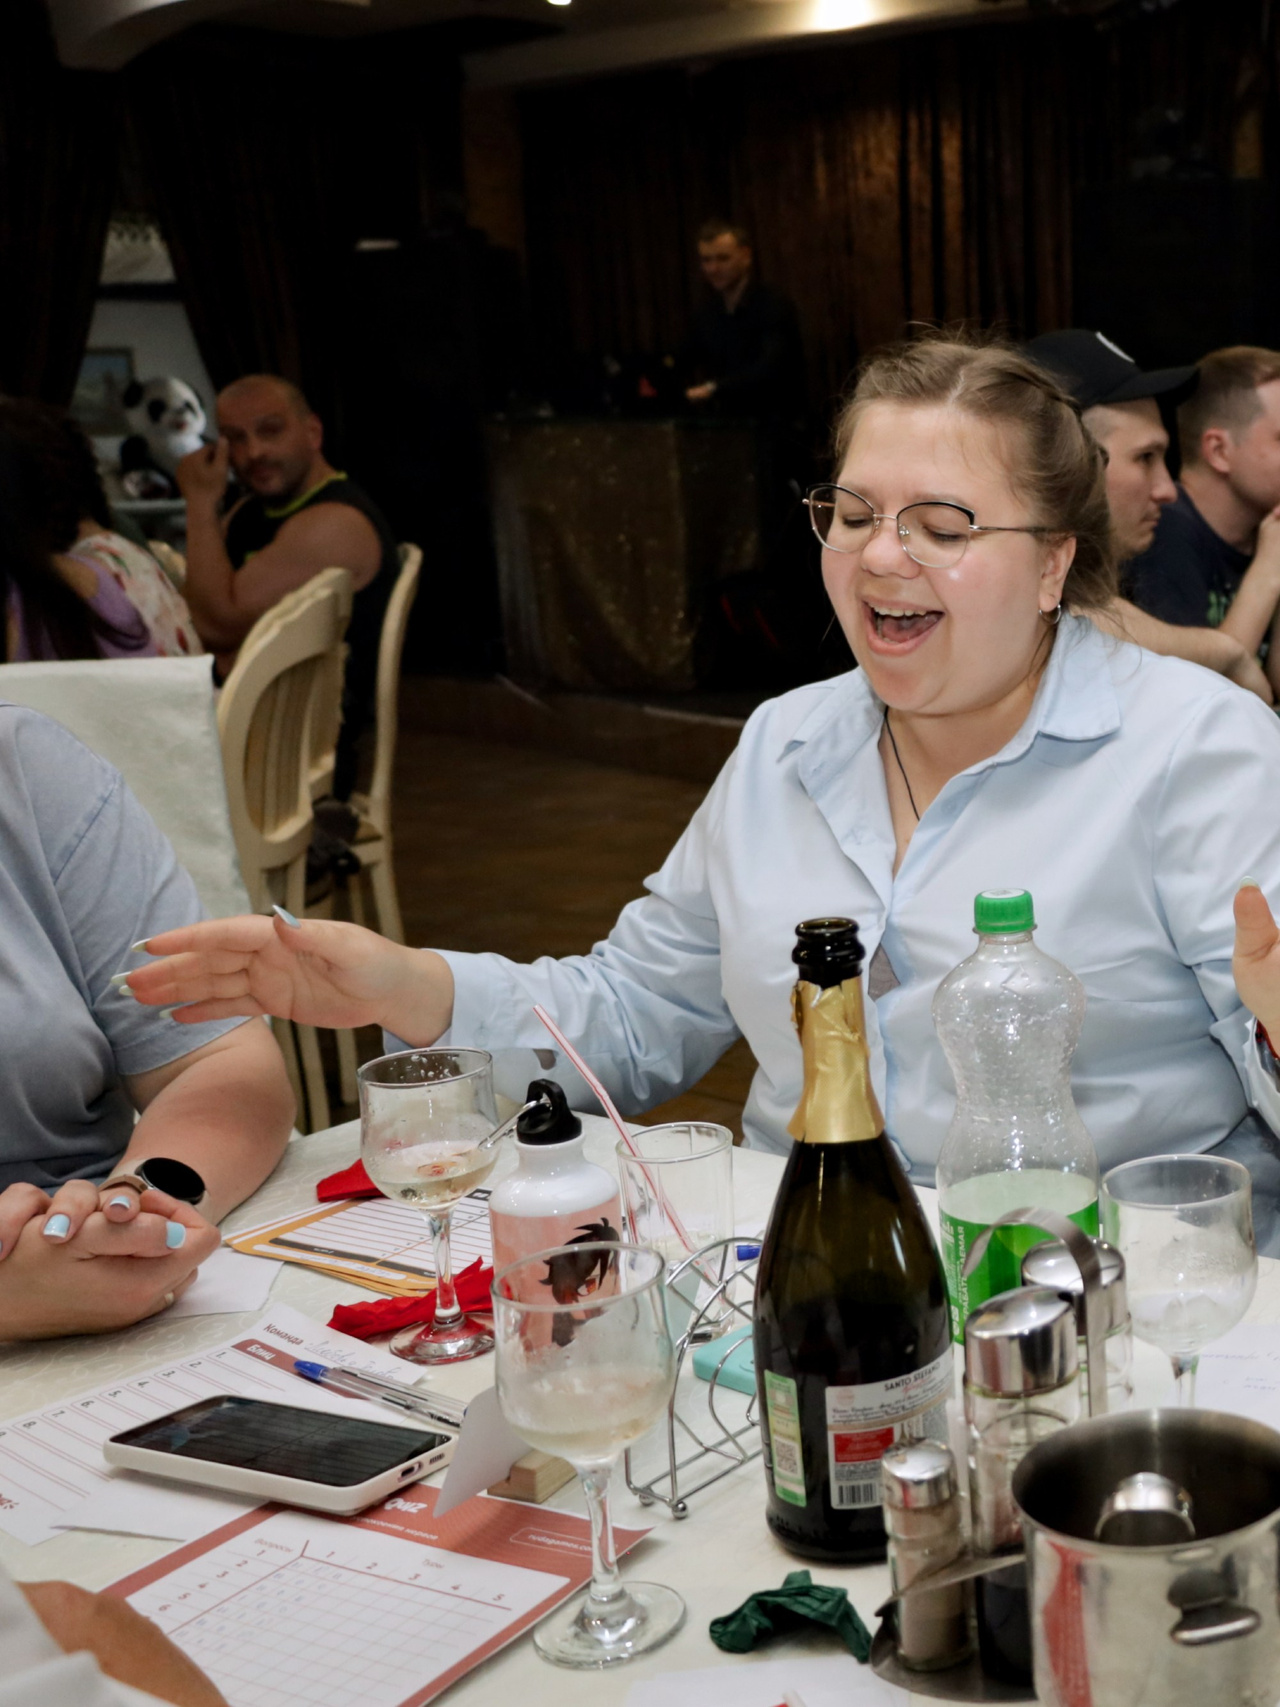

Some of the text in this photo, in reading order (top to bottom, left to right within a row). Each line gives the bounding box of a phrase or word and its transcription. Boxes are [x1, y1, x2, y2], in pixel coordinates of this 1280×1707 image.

[263, 1323, 304, 1345] Команда
[246, 1344, 276, 1360] Блиц
[884, 1377, 911, 1392] SANTO
